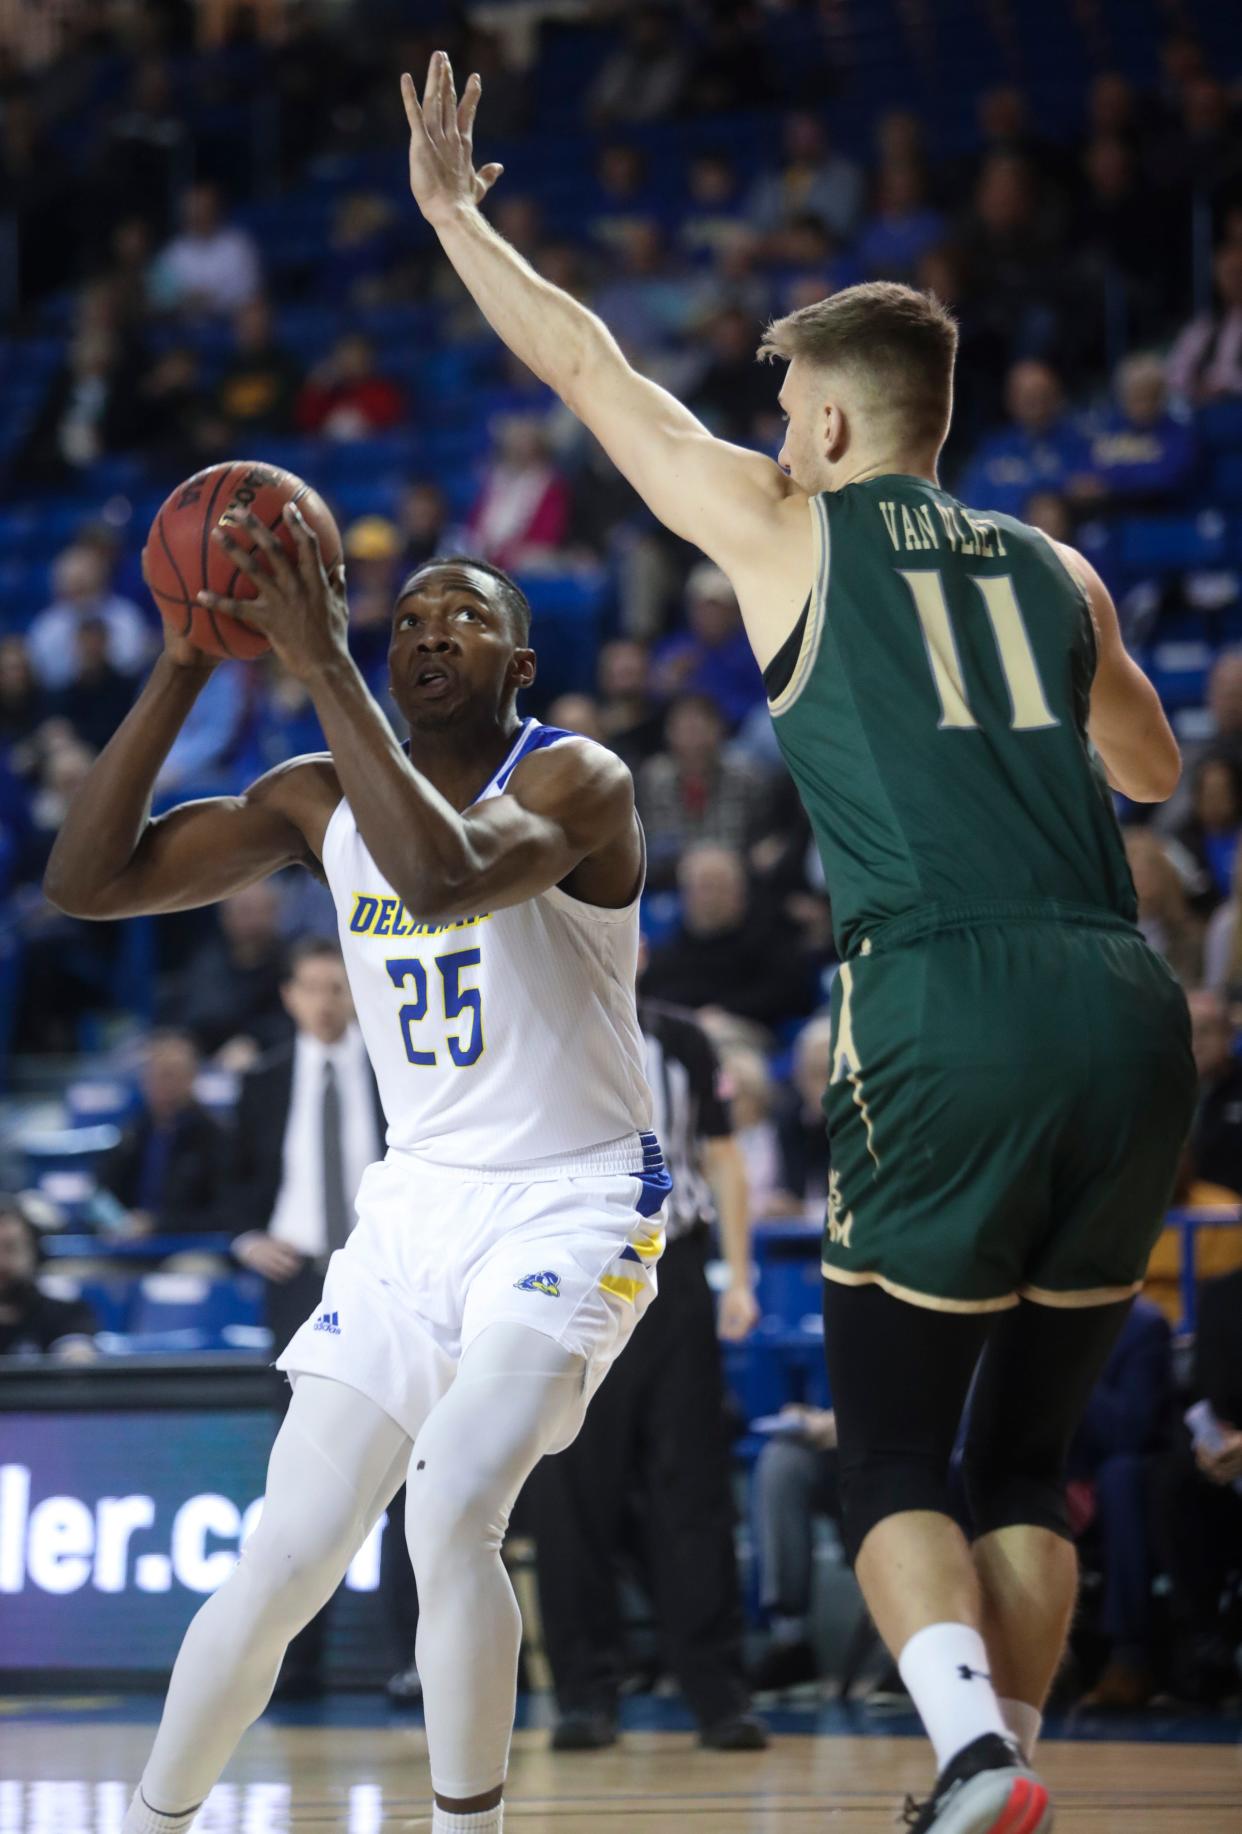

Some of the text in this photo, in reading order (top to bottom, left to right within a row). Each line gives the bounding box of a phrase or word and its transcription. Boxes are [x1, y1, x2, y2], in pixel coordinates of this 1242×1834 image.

[879, 501, 939, 551] VAN
[894, 568, 1061, 731] 11
[384, 946, 484, 1068] 25
